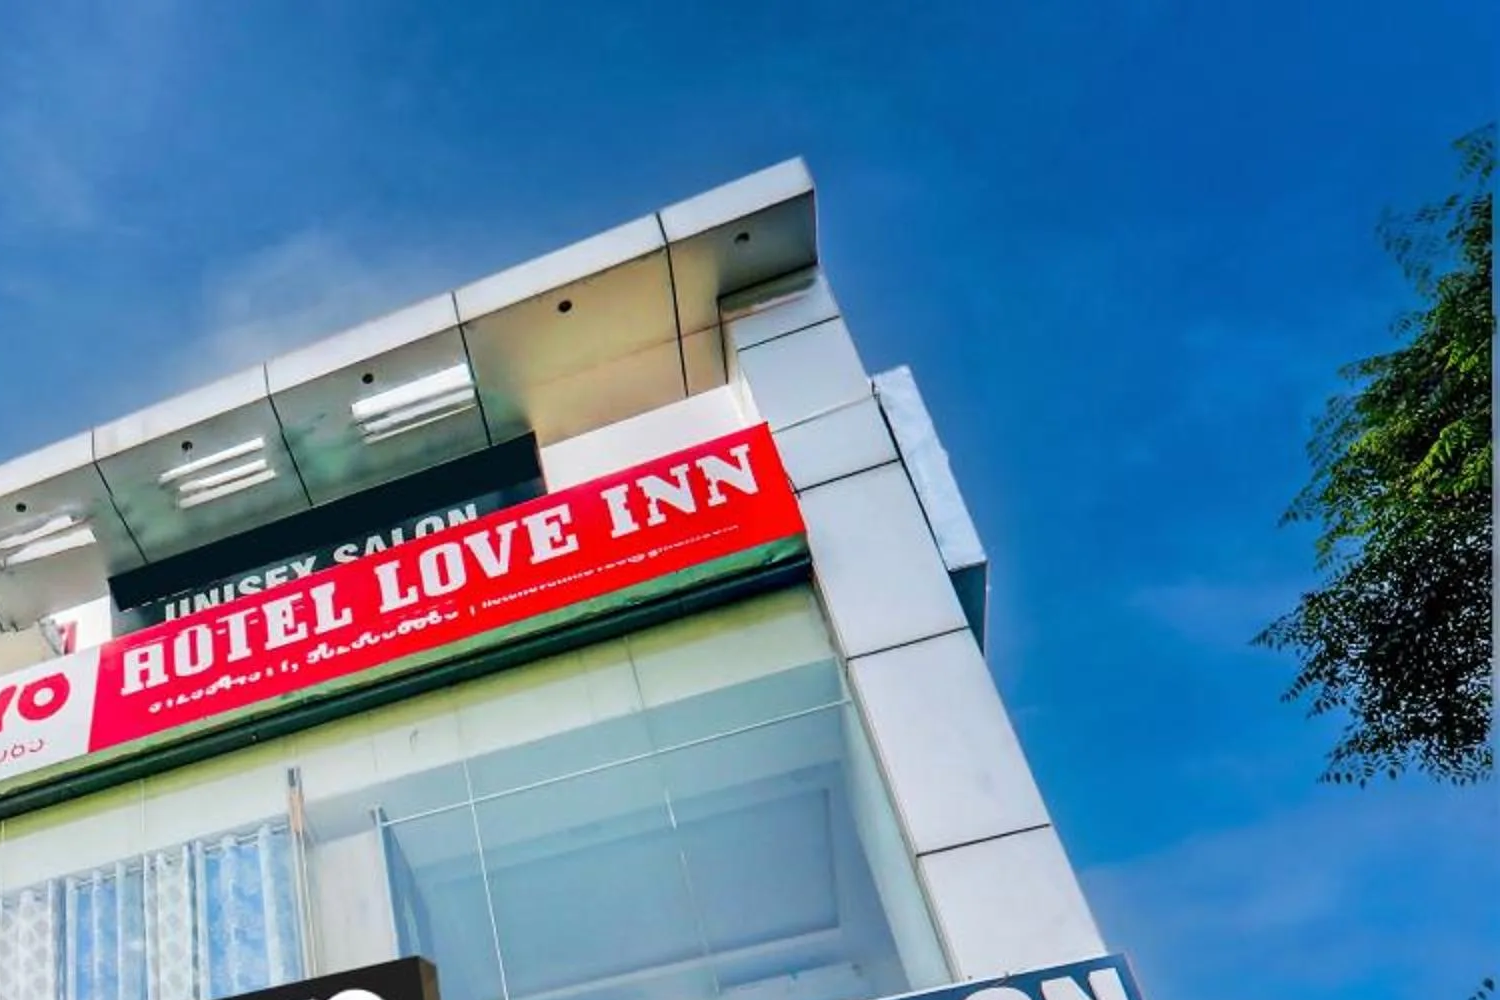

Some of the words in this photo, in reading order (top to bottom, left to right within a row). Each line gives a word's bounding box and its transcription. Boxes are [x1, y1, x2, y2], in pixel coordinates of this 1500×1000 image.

[120, 581, 351, 696] HOTEL
[374, 504, 579, 614] LOVE
[601, 443, 759, 539] INN
